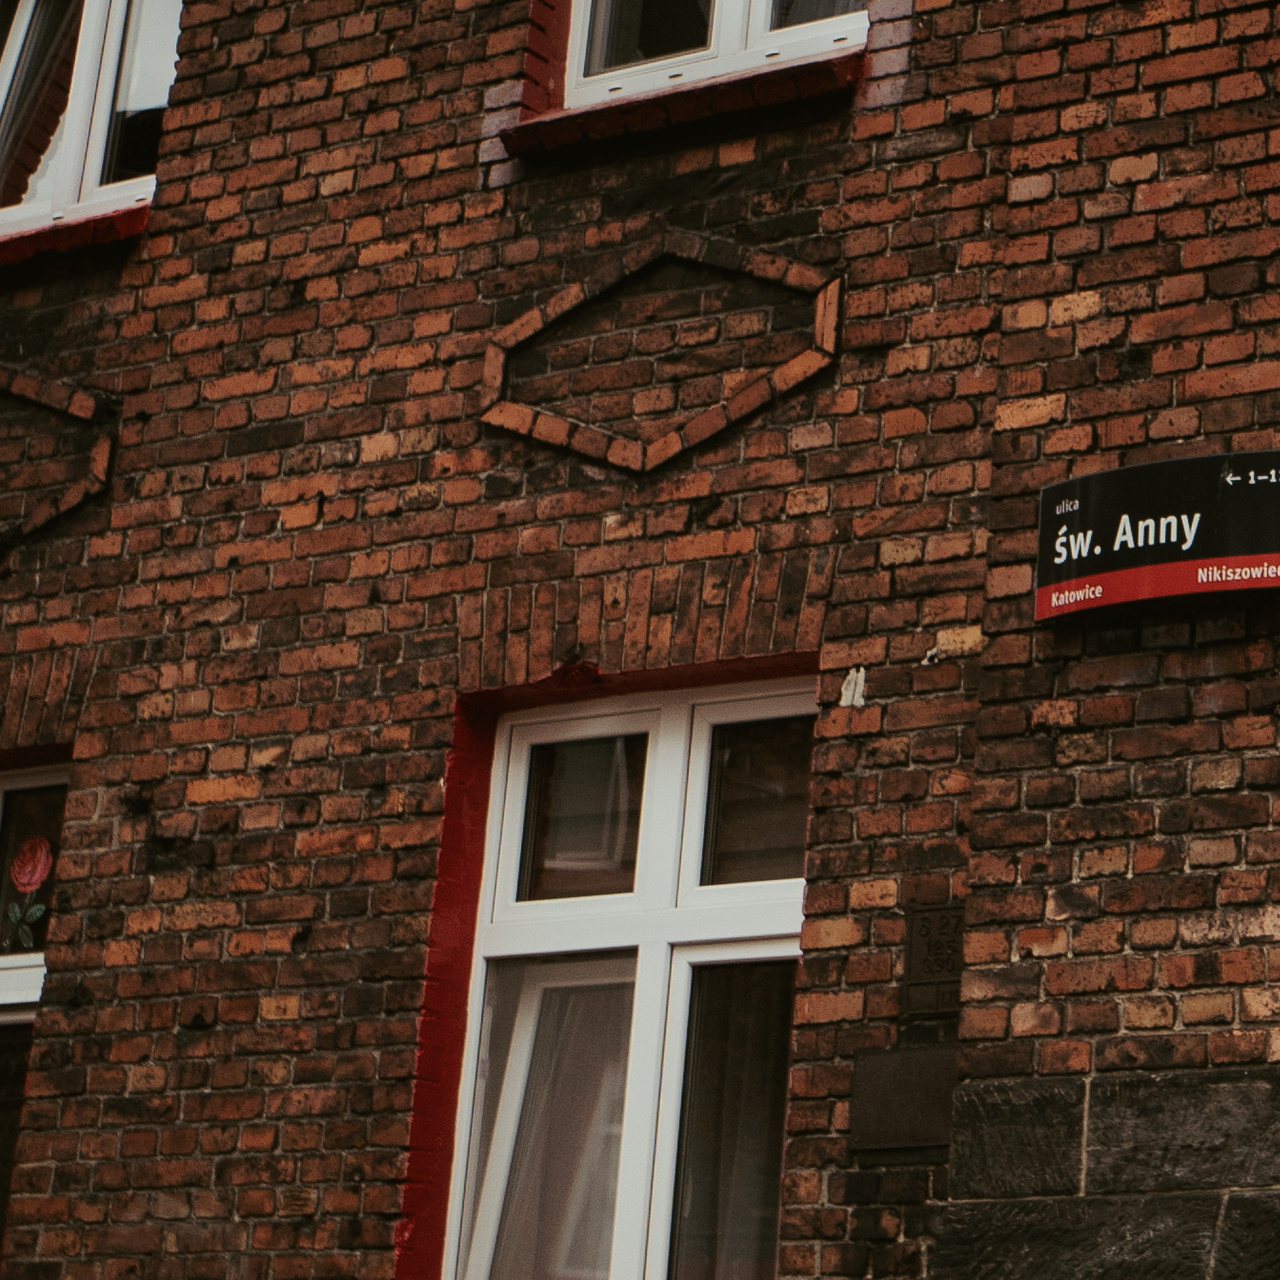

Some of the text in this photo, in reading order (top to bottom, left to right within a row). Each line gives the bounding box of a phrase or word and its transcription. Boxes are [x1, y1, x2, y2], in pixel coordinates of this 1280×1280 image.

[1055, 499, 1080, 516] ulica
[1054, 512, 1201, 565] św. Anny
[1051, 584, 1103, 608] Katowice
